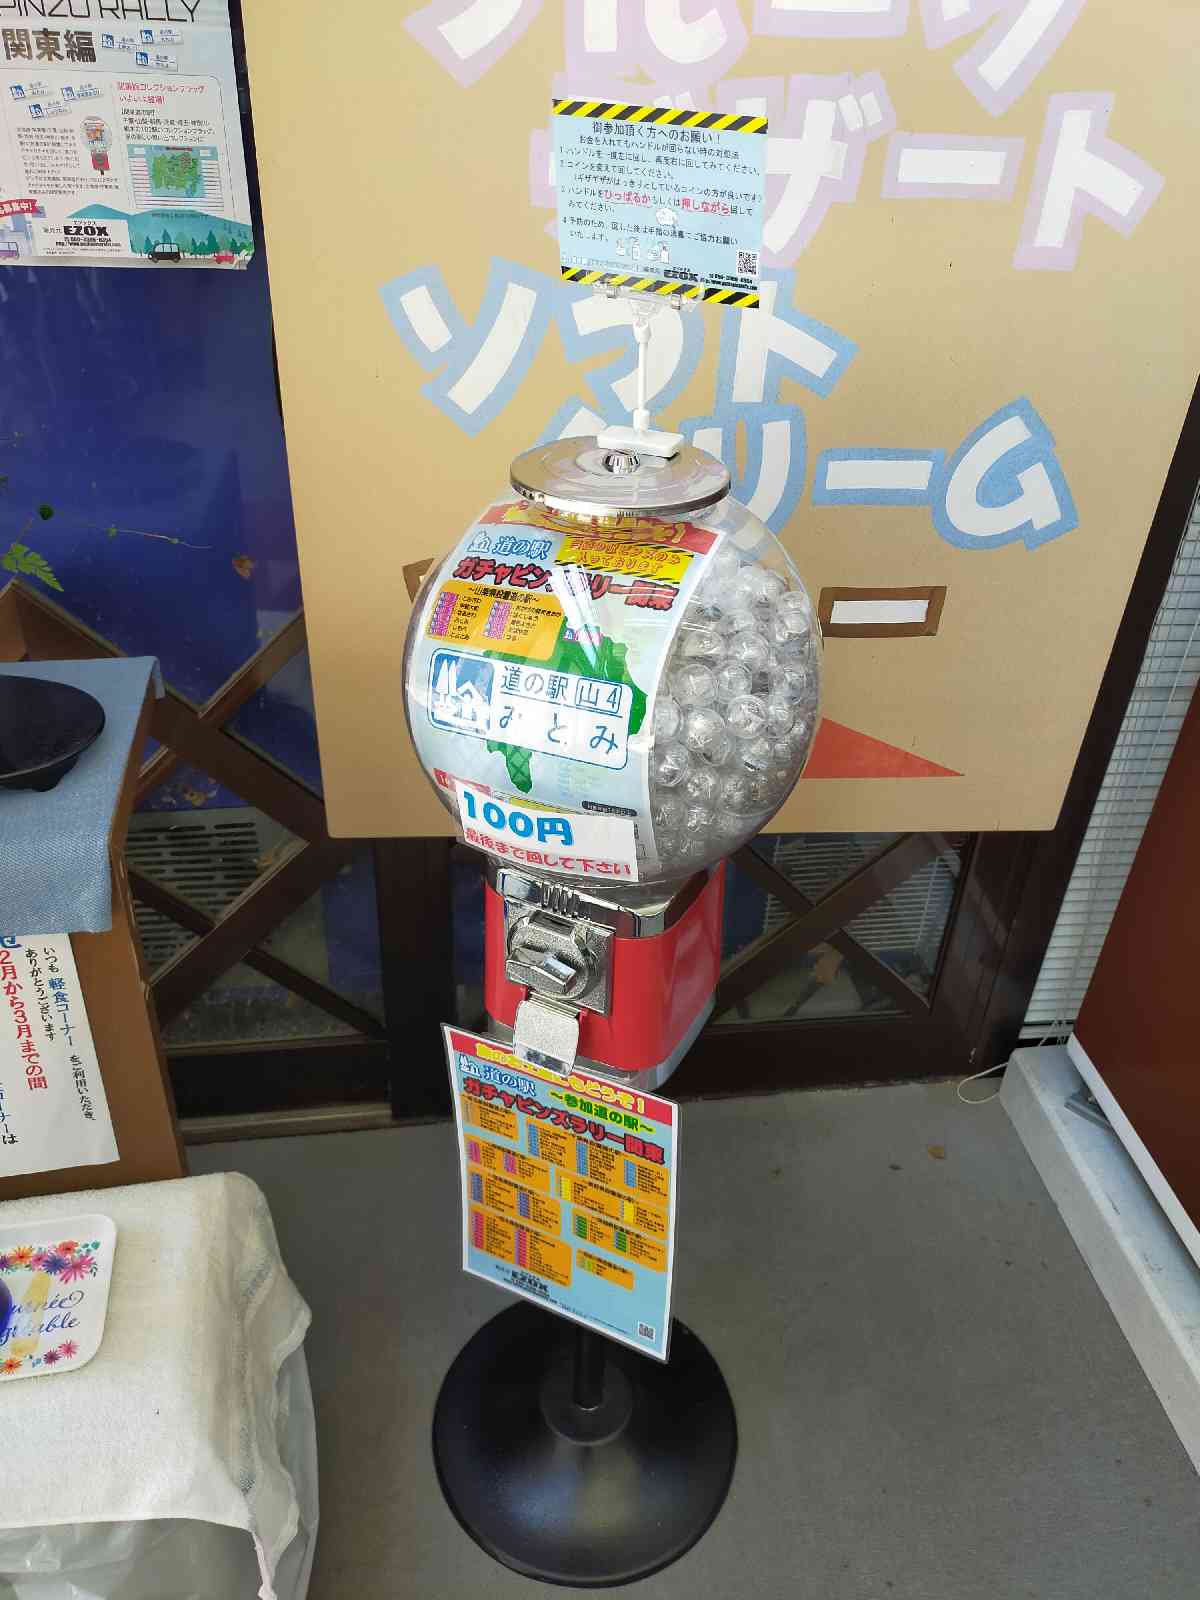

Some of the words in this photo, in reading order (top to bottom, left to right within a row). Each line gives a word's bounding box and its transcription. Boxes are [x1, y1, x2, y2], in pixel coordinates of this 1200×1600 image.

[1, 27, 97, 63] 関東編
[63, 225, 110, 237] EZOX
[493, 535, 552, 561] 道の駅
[500, 665, 569, 700] 道の駅
[463, 790, 575, 846] 100円
[465, 826, 632, 875] 最後まで回して下さい
[43, 946, 60, 973] いつも
[25, 948, 57, 1042] ありがとうございます
[48, 977, 76, 1047] 軽食コーナー
[483, 1065, 537, 1098] 道の駅
